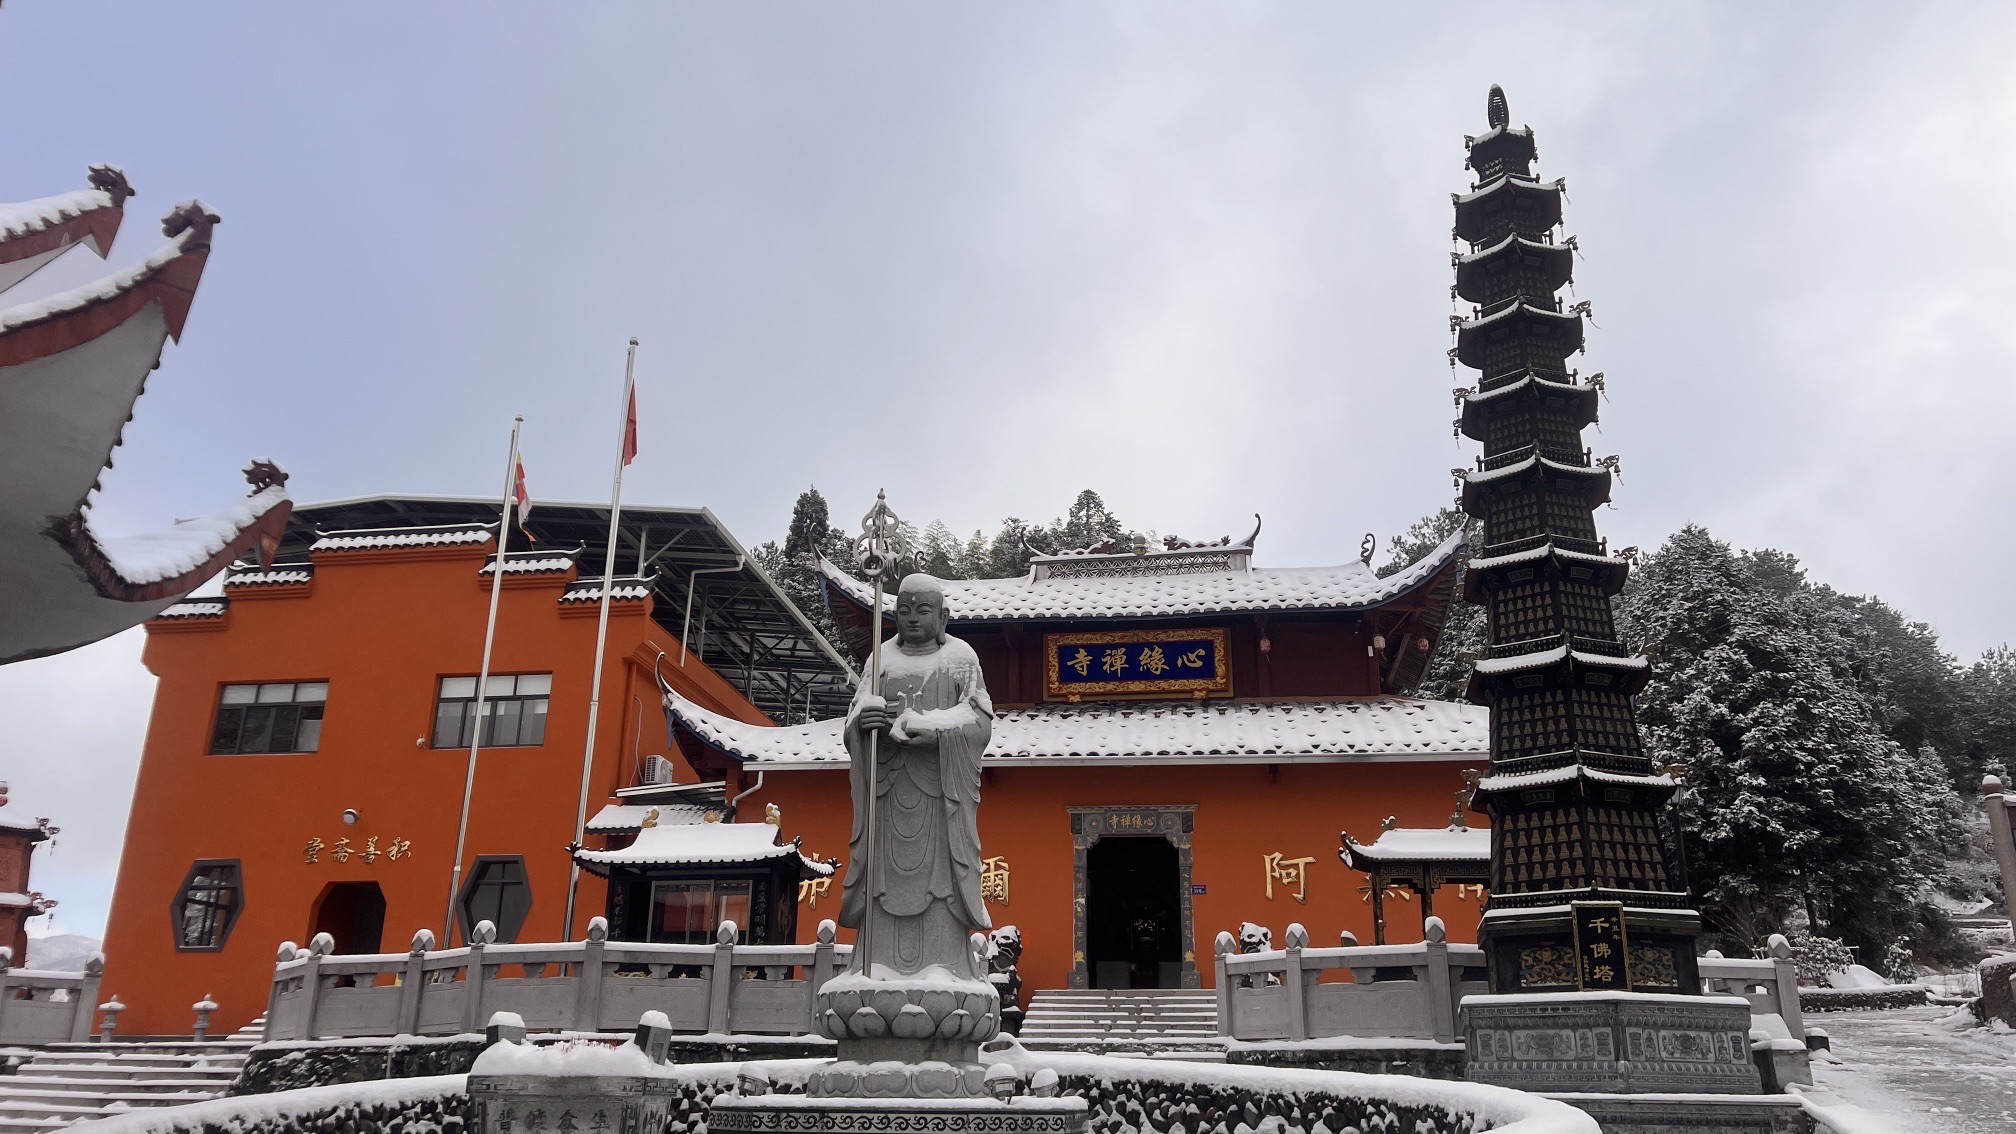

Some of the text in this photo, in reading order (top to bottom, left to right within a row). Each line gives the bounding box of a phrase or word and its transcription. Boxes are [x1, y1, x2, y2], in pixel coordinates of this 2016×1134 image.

[1066, 645, 1206, 678] 心緣禪寺
[1588, 917, 1614, 984] 千佛塔
